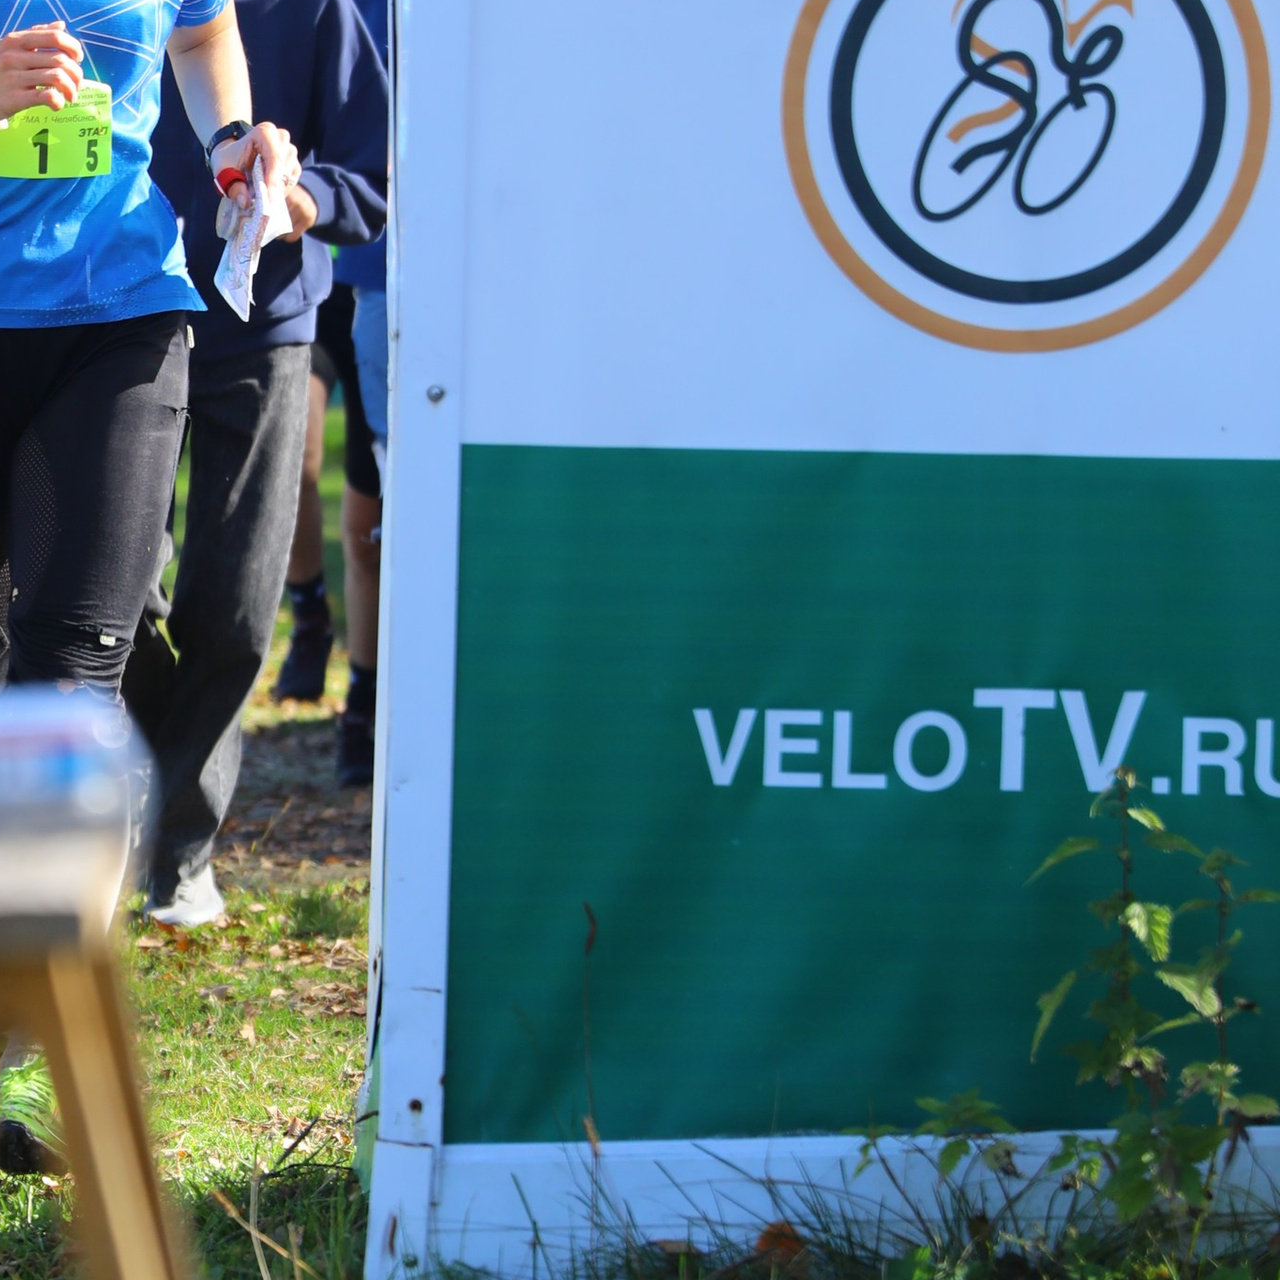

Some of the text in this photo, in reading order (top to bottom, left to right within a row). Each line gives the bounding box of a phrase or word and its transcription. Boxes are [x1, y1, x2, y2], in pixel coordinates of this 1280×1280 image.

[78, 126, 109, 138] ЭТАП
[31, 128, 49, 175] 1
[85, 139, 99, 172] 5
